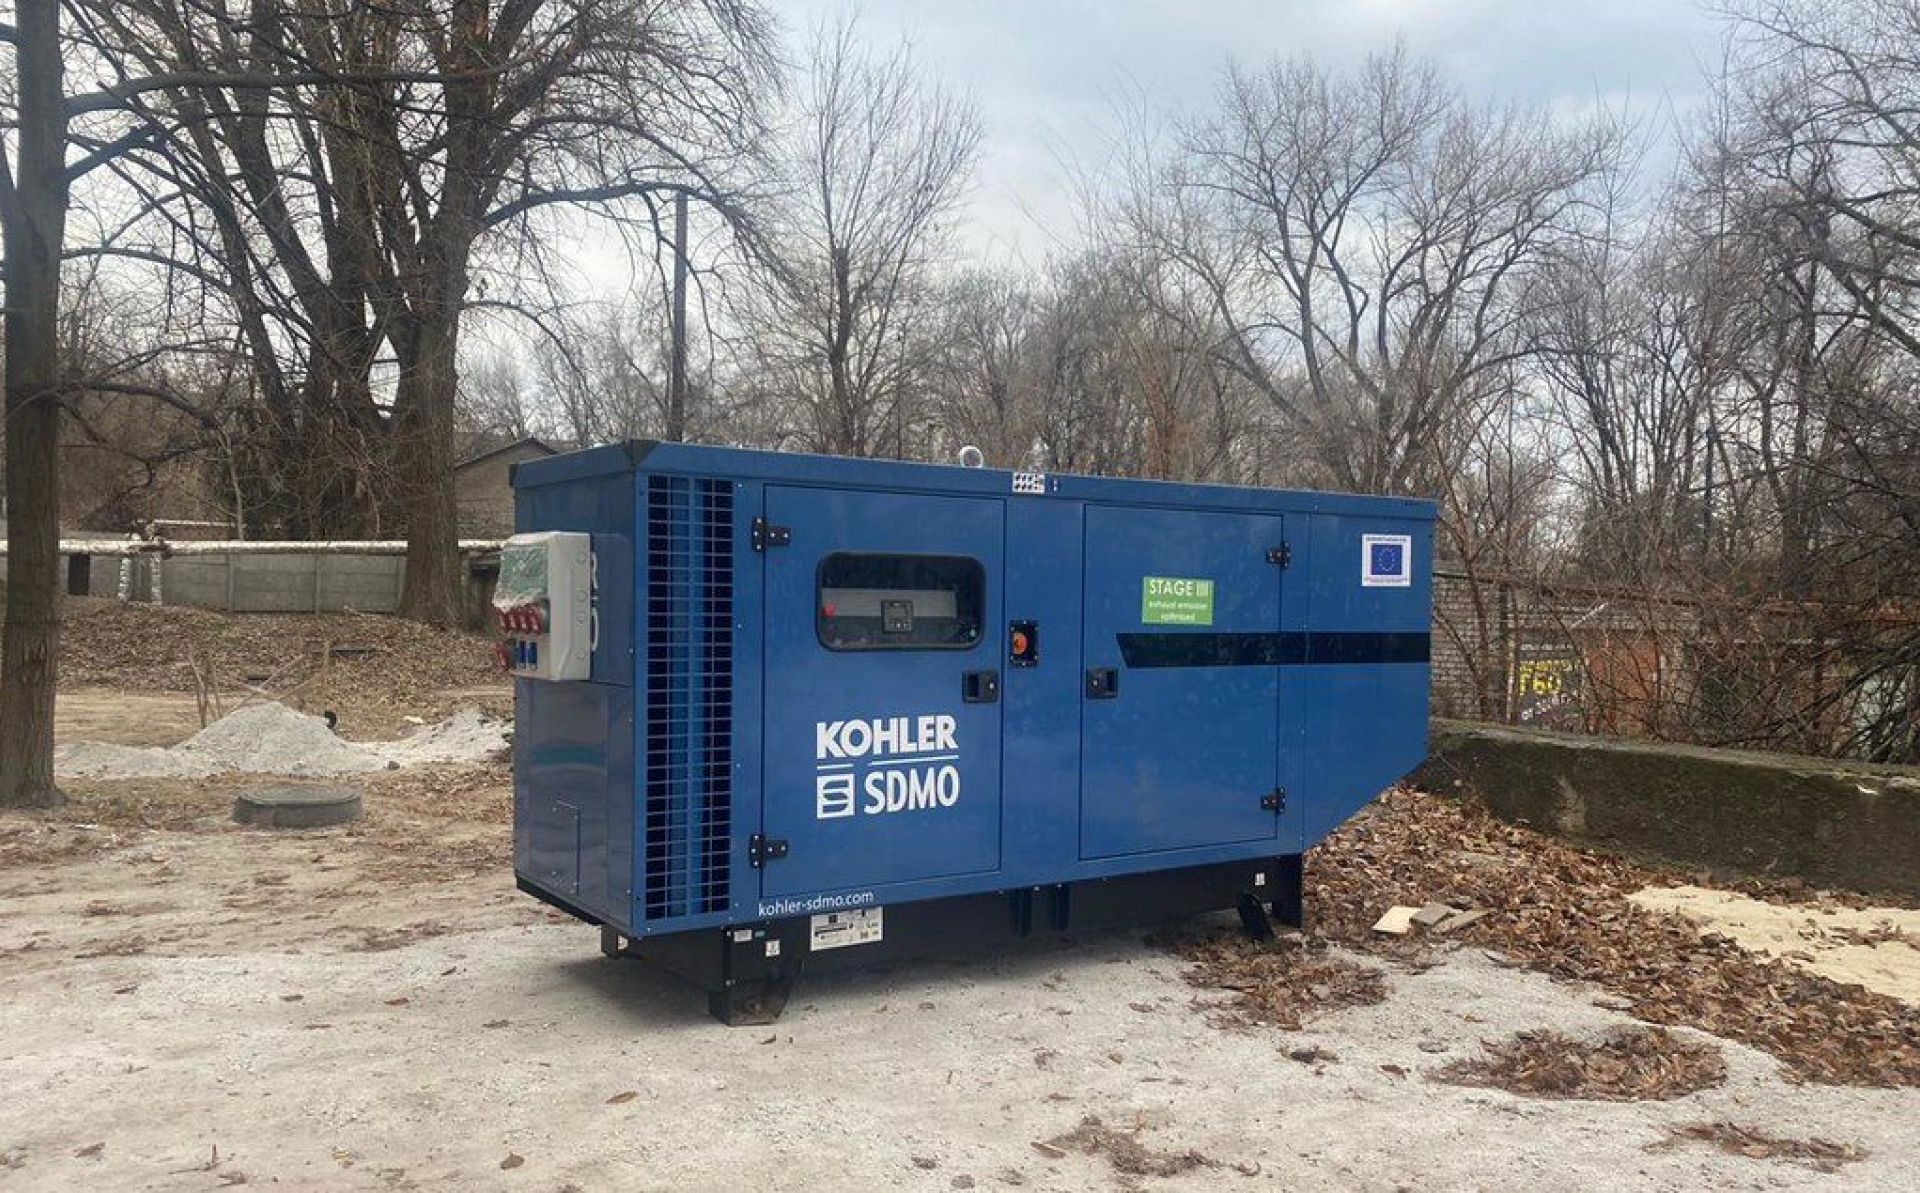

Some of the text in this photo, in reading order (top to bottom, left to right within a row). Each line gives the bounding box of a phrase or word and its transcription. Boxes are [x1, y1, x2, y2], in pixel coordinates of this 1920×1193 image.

[1149, 579, 1194, 596] STAGE
[816, 715, 958, 759] KOHLER
[863, 765, 960, 814] SDMO
[758, 890, 875, 917] kohler-sdmo.com
